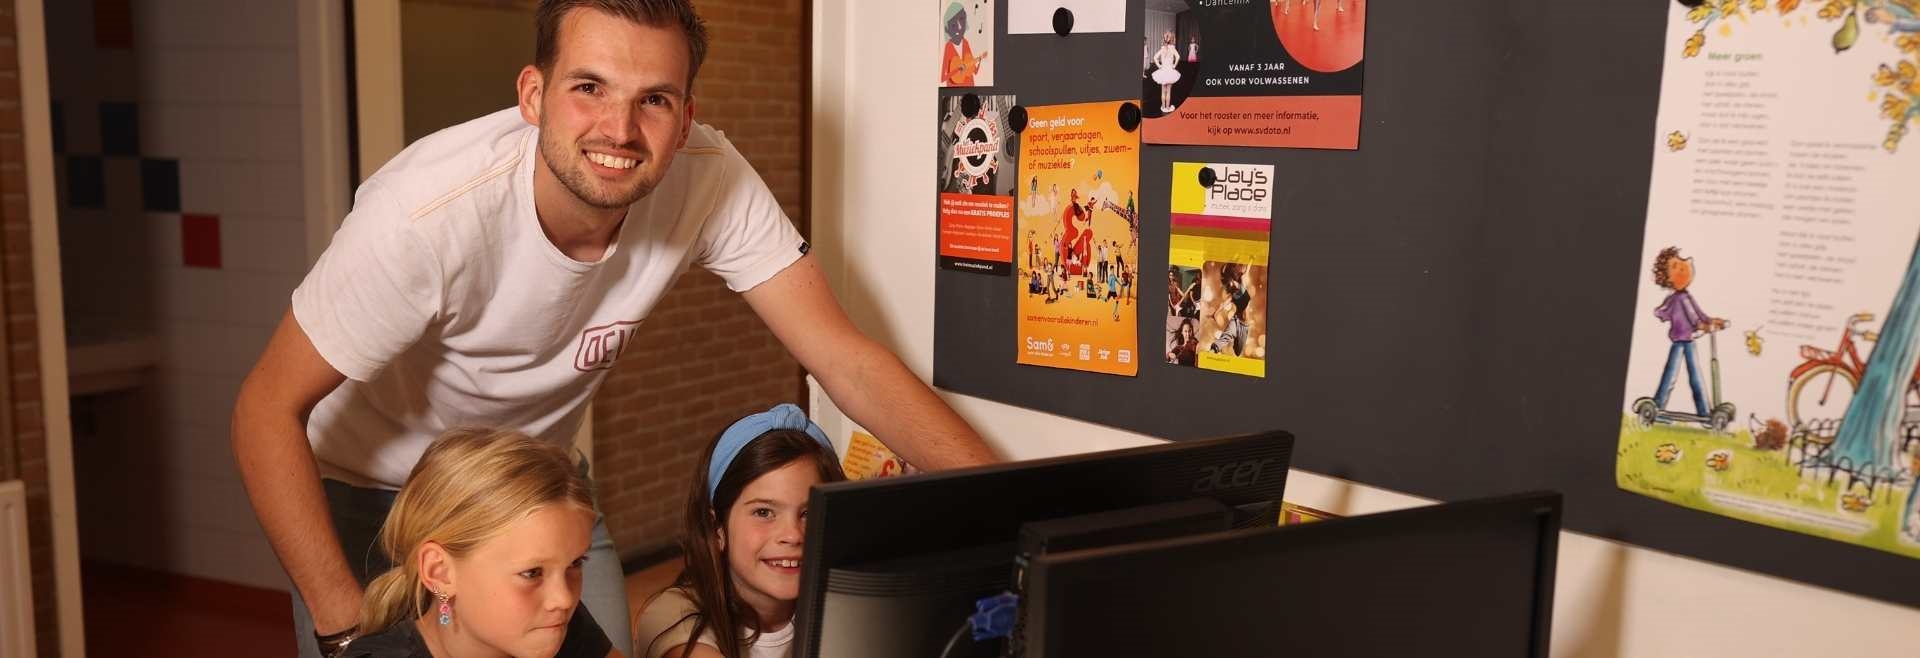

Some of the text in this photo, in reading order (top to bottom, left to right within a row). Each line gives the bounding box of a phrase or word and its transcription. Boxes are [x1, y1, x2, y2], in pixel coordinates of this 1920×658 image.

[1228, 62, 1285, 72] VANAF 3 JAAR
[1205, 76, 1310, 86] OOK VOOR VOLWASSENEN
[1180, 110, 1320, 121] Voor het rooster en meer informatie,
[1028, 116, 1085, 130] Geen geld voor
[1029, 129, 1104, 145] sport, verjaardagen,
[1207, 126, 1221, 136] kijk
[1223, 127, 1233, 136] op
[953, 137, 1000, 160] Muziekpand
[1028, 145, 1078, 158] schoolspullen,
[1103, 145, 1133, 154] zwem-
[1028, 158, 1075, 170] of muziekles?
[1213, 166, 1268, 187] Jay's
[1211, 184, 1267, 201] Place
[1194, 458, 1278, 493] acer
